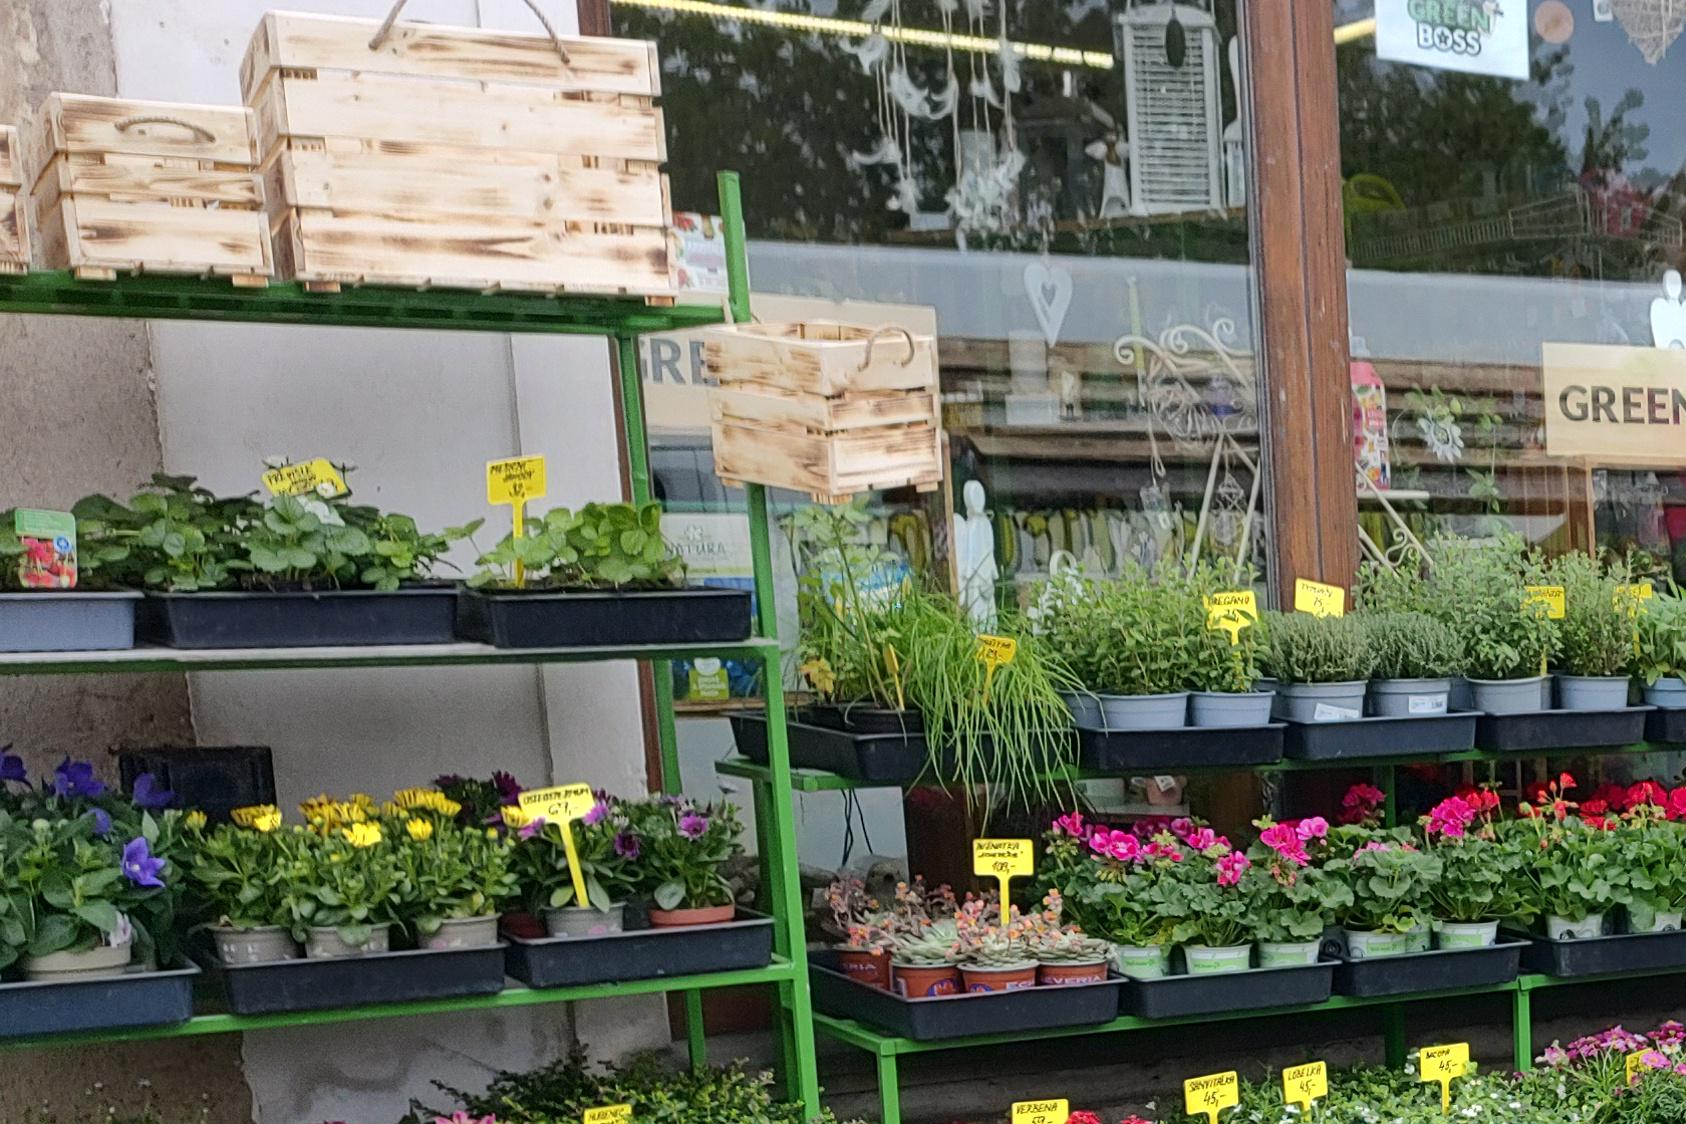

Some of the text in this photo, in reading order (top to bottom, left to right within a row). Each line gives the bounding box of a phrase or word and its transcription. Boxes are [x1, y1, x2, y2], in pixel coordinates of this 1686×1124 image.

[1408, 0, 1490, 34] GREEN
[1417, 21, 1481, 56] BOSS
[1288, 1064, 1321, 1081] LOBELKA
[1299, 1079, 1317, 1096] 45,-
[1203, 1091, 1227, 1108] 45,-
[1016, 1102, 1058, 1115] VERBENA
